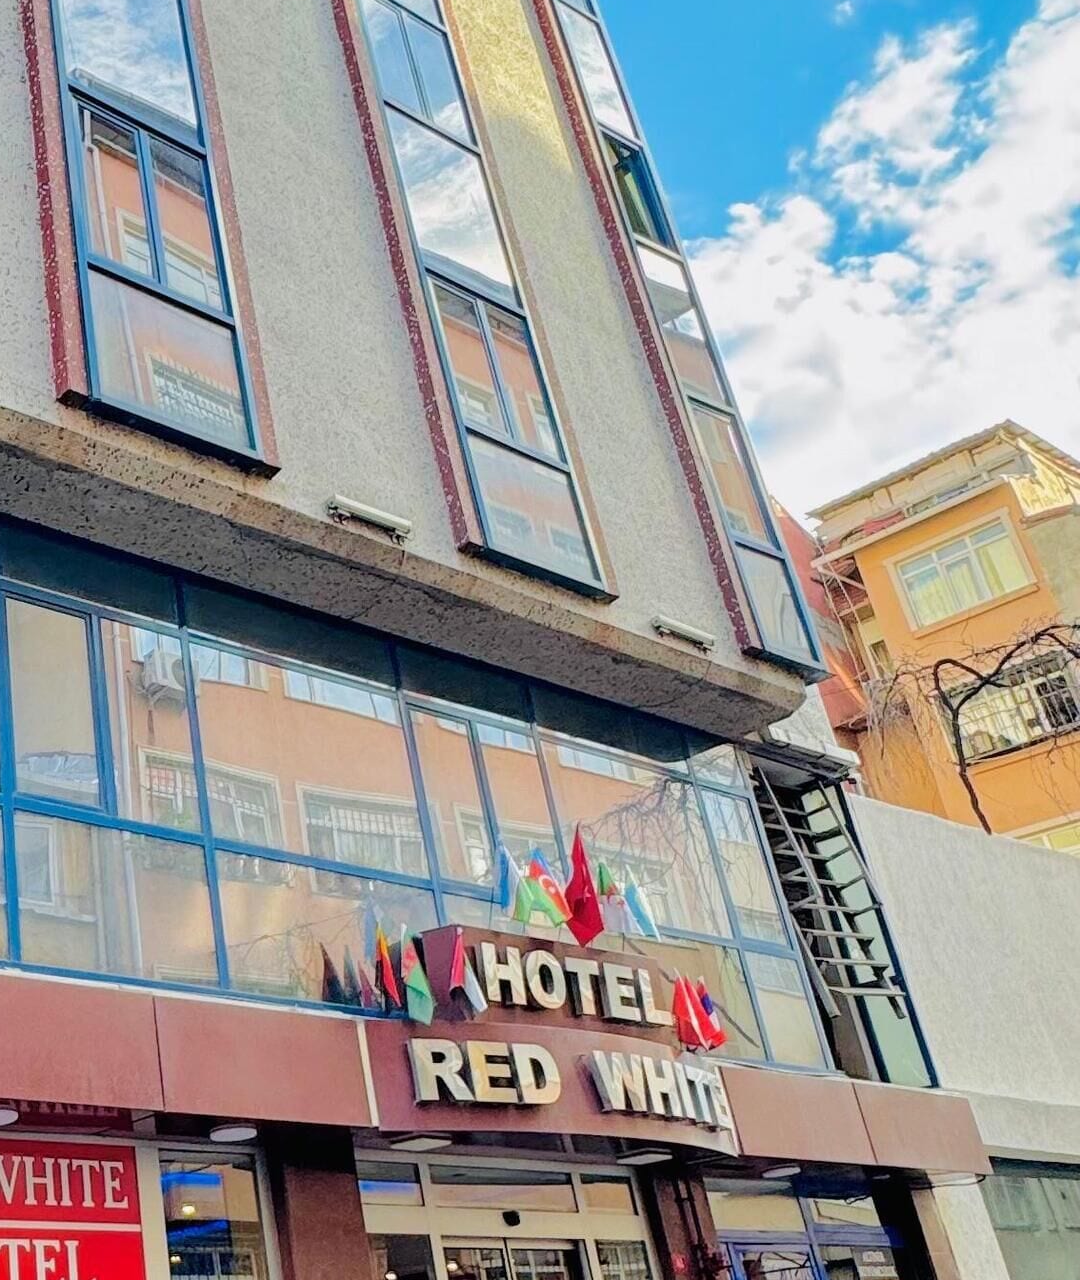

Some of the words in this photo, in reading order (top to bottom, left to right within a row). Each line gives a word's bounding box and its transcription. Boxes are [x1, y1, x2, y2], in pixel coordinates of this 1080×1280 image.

[480, 941, 674, 1026] HOTEL
[411, 1038, 561, 1105] RED
[591, 1049, 732, 1129] WHITE
